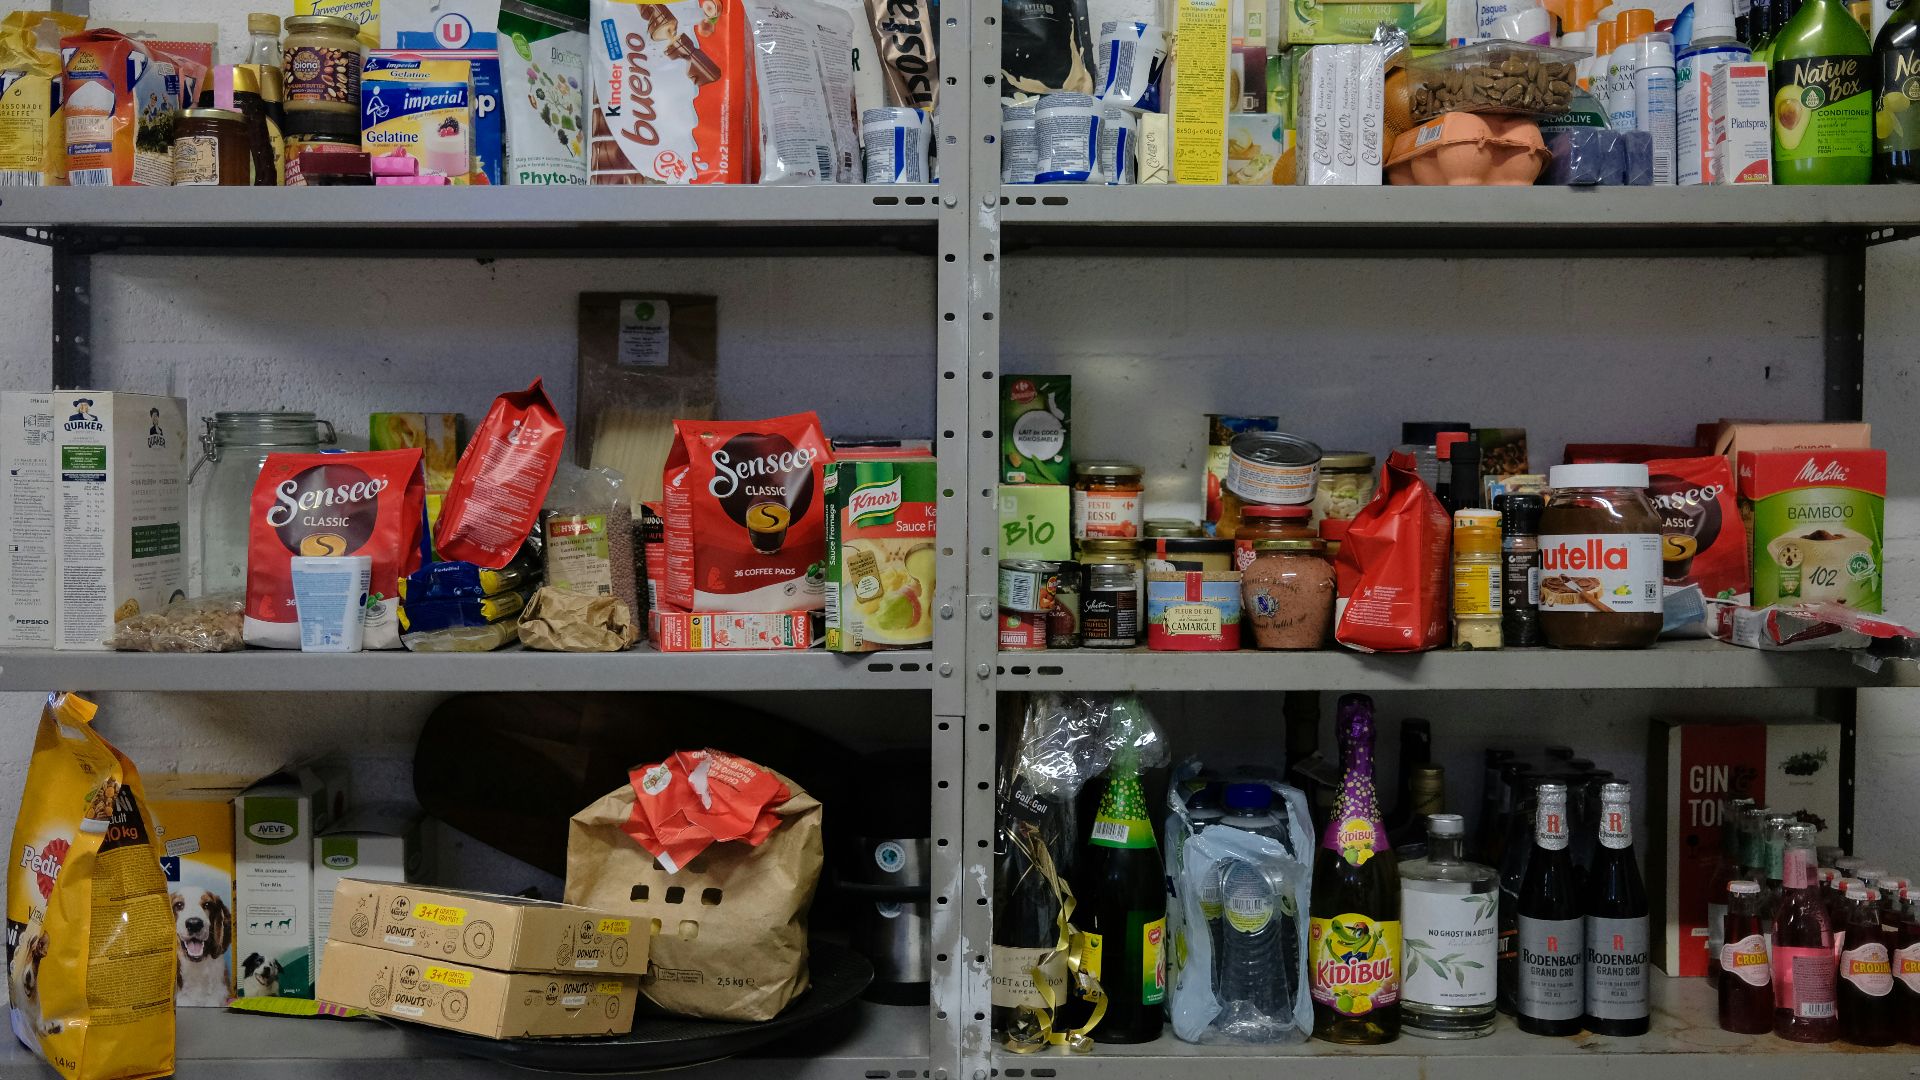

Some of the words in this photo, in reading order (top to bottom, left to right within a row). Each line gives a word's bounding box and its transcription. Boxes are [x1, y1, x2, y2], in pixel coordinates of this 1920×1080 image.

[1481, 4, 1508, 15] Disques
[360, 9, 379, 25] Dur
[442, 23, 462, 42] U
[295, 61, 318, 70] biona
[386, 61, 419, 69] imperial
[1793, 58, 1858, 86] Nature
[605, 63, 623, 117] kinder
[621, 32, 660, 146] bueno
[1828, 78, 1861, 102] Box
[403, 90, 464, 111] imperial
[1817, 109, 1870, 117] CONDITIONER
[1731, 117, 1768, 130] Plantspray
[366, 130, 419, 143] Gelatine
[63, 421, 104, 432] QUAKER
[708, 447, 818, 499] Senseo
[1793, 457, 1848, 483] Melitta
[745, 485, 787, 497] CLASSIC
[266, 474, 389, 528] Senseo
[853, 489, 900, 513] Knorr
[1787, 505, 1854, 520] BAMBOO
[303, 516, 350, 527] CLASSIC
[896, 520, 926, 532] Sauce
[734, 569, 744, 577] 36
[744, 568, 773, 577] COFFEE
[773, 567, 796, 576] PADS
[1808, 566, 1838, 587] 102
[1171, 622, 1217, 632] CAMARGUE
[1689, 765, 1730, 794] GIN
[1546, 813, 1560, 833] R
[1607, 812, 1623, 832] R
[122, 825, 138, 840] kg
[257, 825, 286, 834] AVEVE
[331, 856, 349, 864] AVEVE
[385, 924, 417, 938] DONUTS
[1428, 928, 1439, 937] NO
[1440, 928, 1464, 938] GHOST
[1465, 928, 1472, 937] IN
[1546, 935, 1559, 953] R
[1612, 934, 1625, 951] R
[576, 949, 601, 959] DONUTS
[1522, 948, 1581, 967] RODENBACH
[1587, 948, 1648, 967] RODENBACH
[1530, 966, 1557, 978] GRAND
[1559, 966, 1574, 978] CRU
[1596, 965, 1623, 977] GRAND
[1625, 965, 1641, 977] CRU
[563, 982, 590, 994] DONUTS
[717, 976, 732, 987] 2,5
[733, 976, 744, 988] kg
[394, 993, 426, 1007] DONUTS
[65, 1058, 76, 1071] kg
